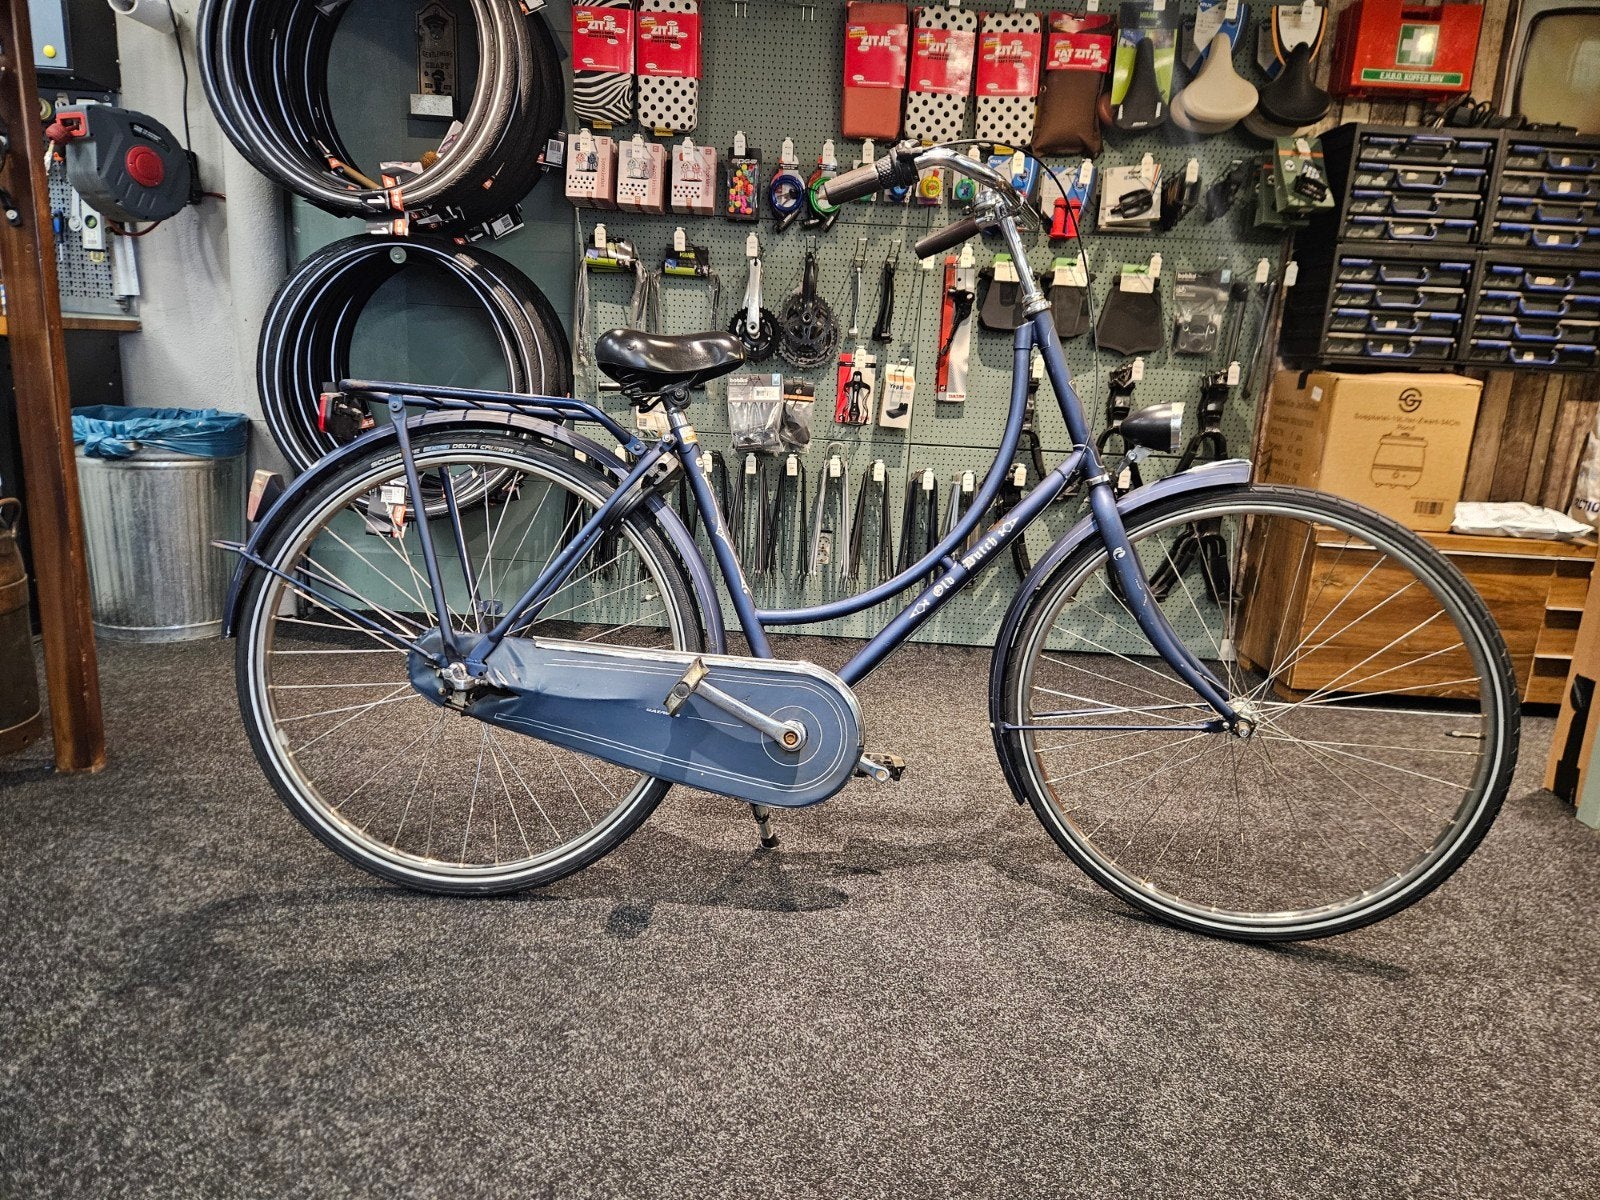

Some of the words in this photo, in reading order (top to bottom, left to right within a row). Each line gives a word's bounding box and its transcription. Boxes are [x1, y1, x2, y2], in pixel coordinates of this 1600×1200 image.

[587, 20, 617, 31] ZITJE
[650, 25, 680, 36] ZITJE
[860, 35, 892, 47] ZITJE
[1403, 73, 1430, 83] KOFFER
